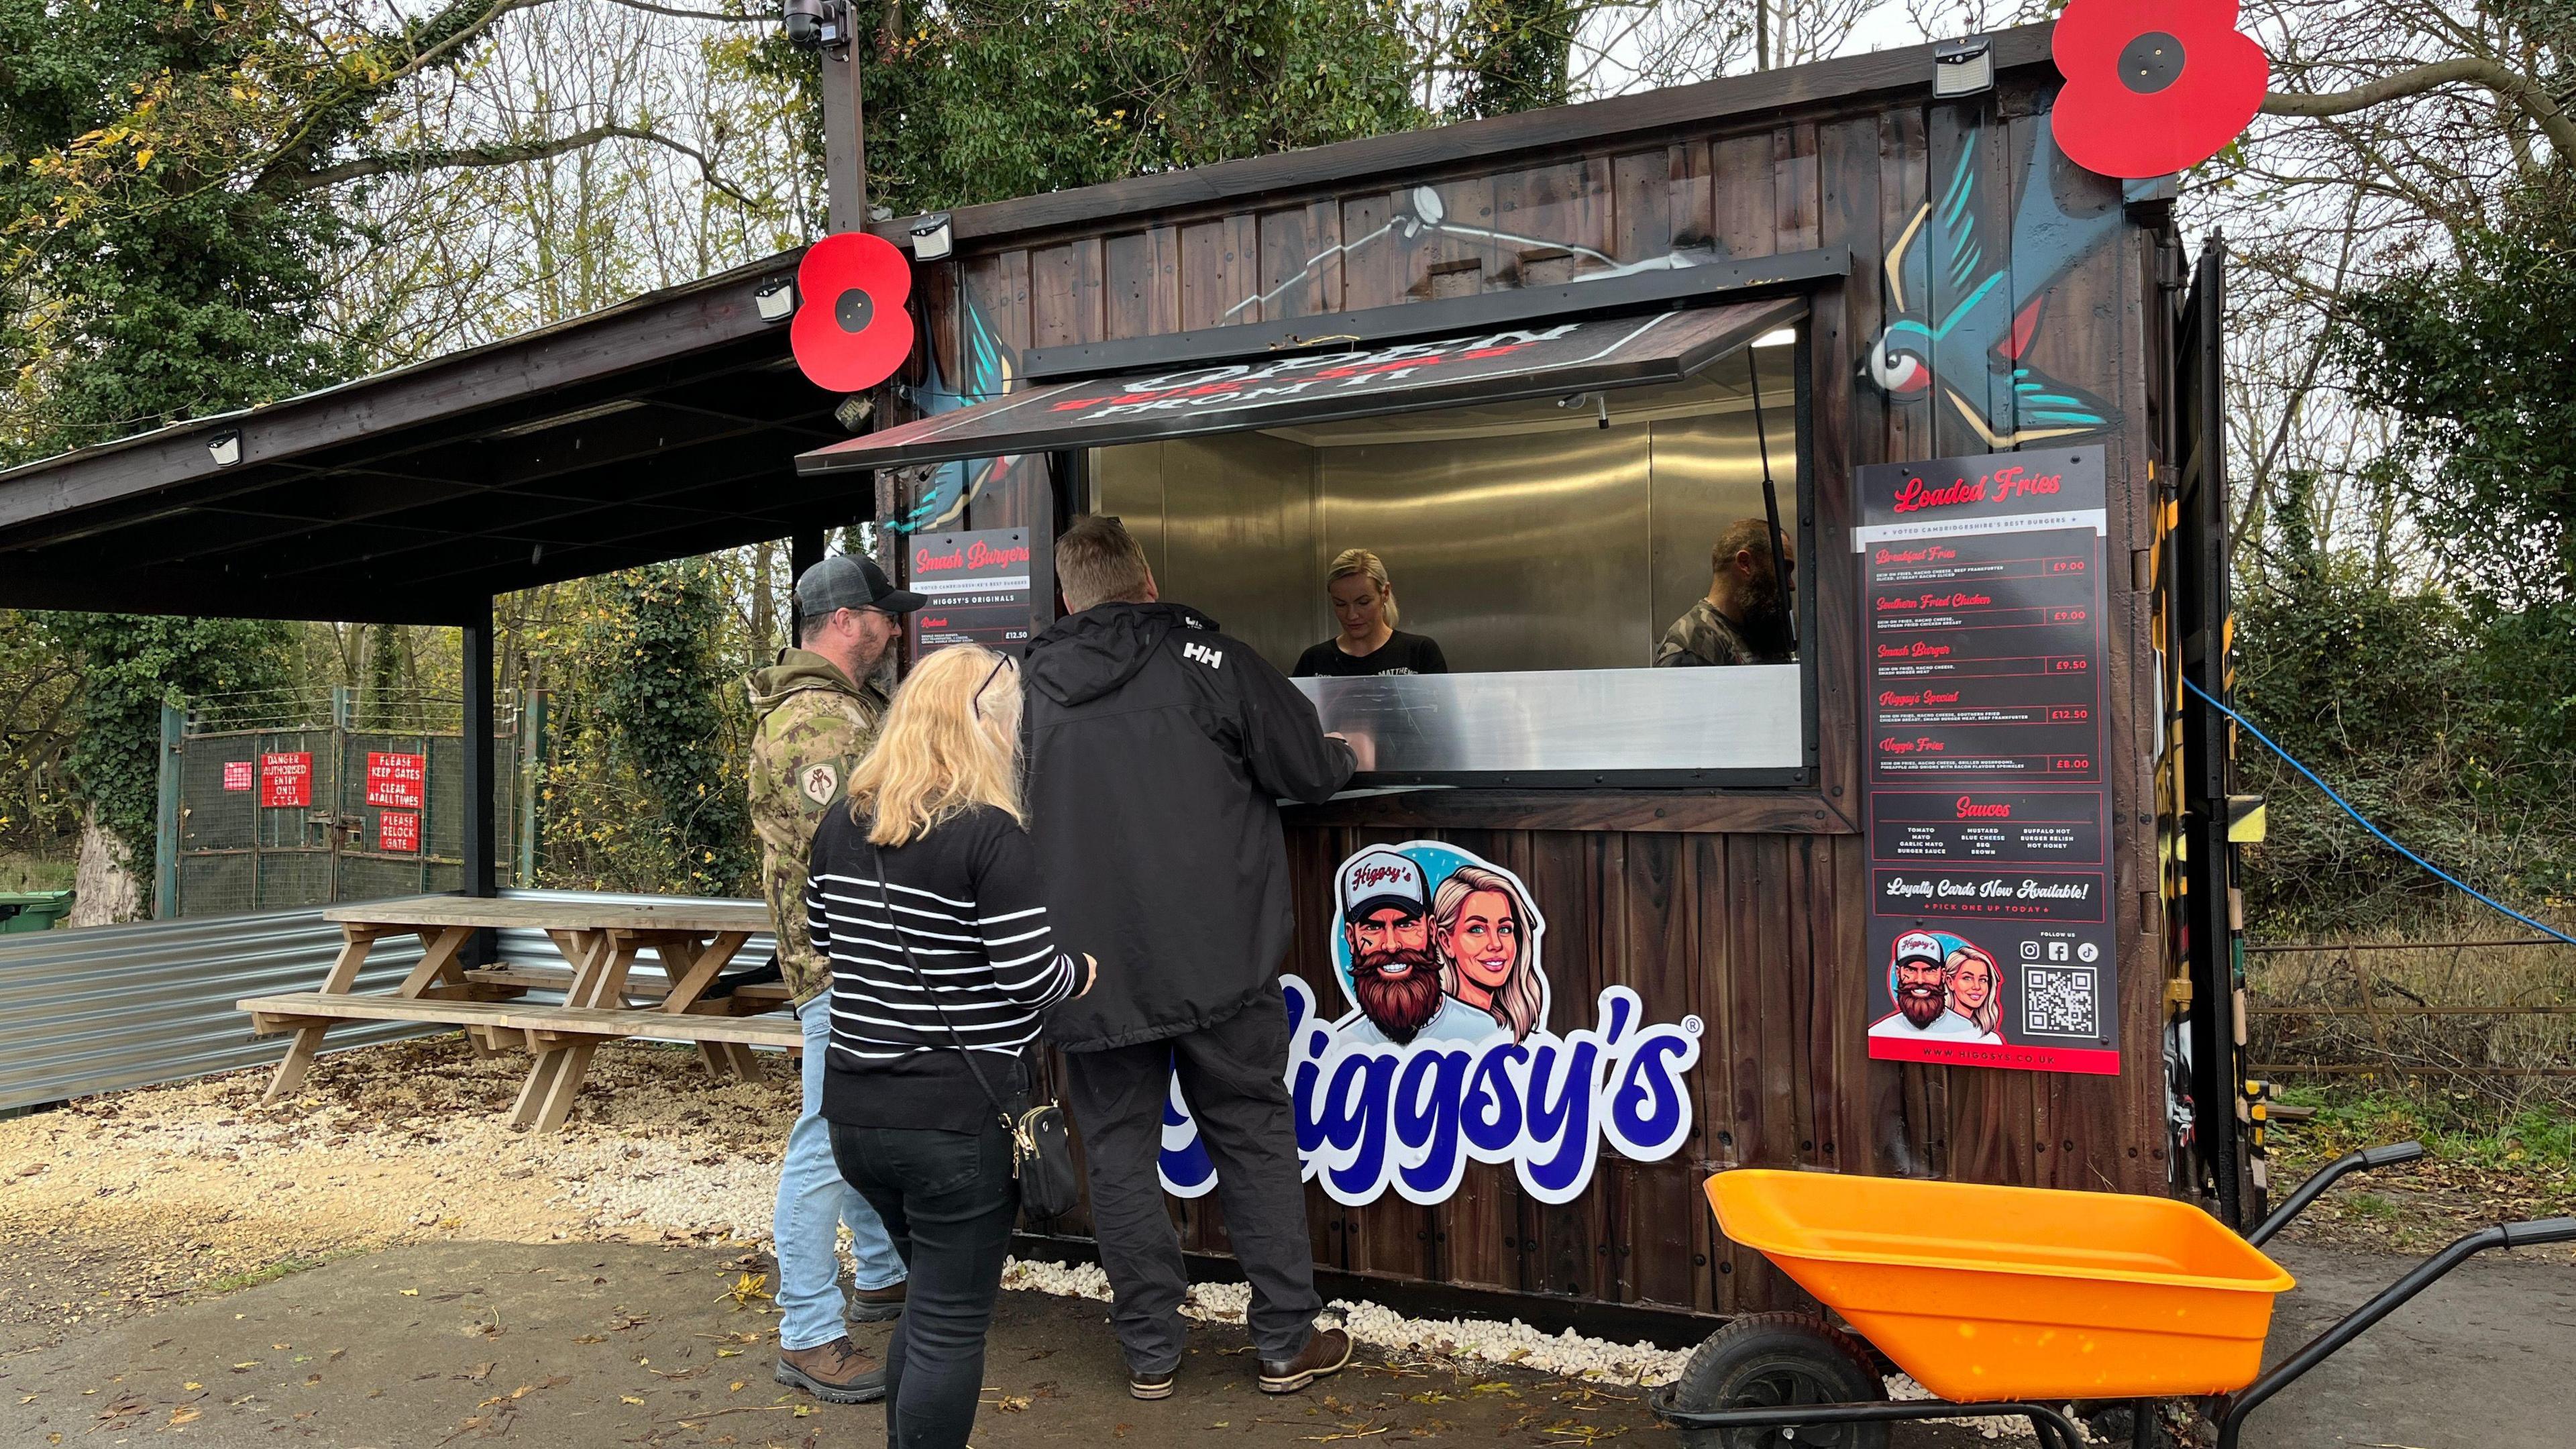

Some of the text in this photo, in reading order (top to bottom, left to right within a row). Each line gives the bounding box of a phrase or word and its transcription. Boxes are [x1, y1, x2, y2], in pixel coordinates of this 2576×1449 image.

[1122, 323, 1582, 392] OPEN
[1076, 380, 1323, 421] FROM
[1894, 466, 2061, 513] Loaded Fries
[1892, 527, 1919, 535] VOTED
[1921, 522, 2001, 533] CAMBRIDGESHIRE'S
[2027, 517, 2066, 526] BURGERS
[915, 539, 1030, 575] Smash Burgers
[1928, 546, 1957, 561] Fries
[2053, 561, 2084, 572] £9.00
[932, 594, 1015, 606] HIGGSY'S ORIGINALS
[1919, 594, 1951, 609] Fried
[2055, 611, 2086, 621] £9.00
[1005, 631, 1028, 639] £12.50
[1183, 642, 1222, 669] HH
[1878, 641, 1951, 658] Smash Burger
[2056, 660, 2087, 670] £9.50
[1923, 689, 1960, 705] Special
[2051, 710, 2088, 720] £12.50
[1879, 737, 1945, 754] Veggie Fries
[268, 755, 299, 765] DANGER
[380, 756, 411, 767] PLEASE
[2056, 759, 2089, 768] £8.00
[263, 765, 307, 775] AUTHORISED
[371, 767, 420, 780] KEEP GATES
[274, 775, 297, 786] ENTRY
[276, 786, 296, 795] ONLY
[380, 783, 406, 794] CLEAR
[394, 794, 419, 806] TIMES
[1956, 796, 2011, 818] Sauces
[383, 815, 413, 826] PLEASE
[382, 826, 414, 838] RELOCK
[386, 839, 407, 849] GATE
[1352, 863, 1411, 891] Higgsy's
[1886, 877, 2090, 900] Loyalty Cards Now Available!
